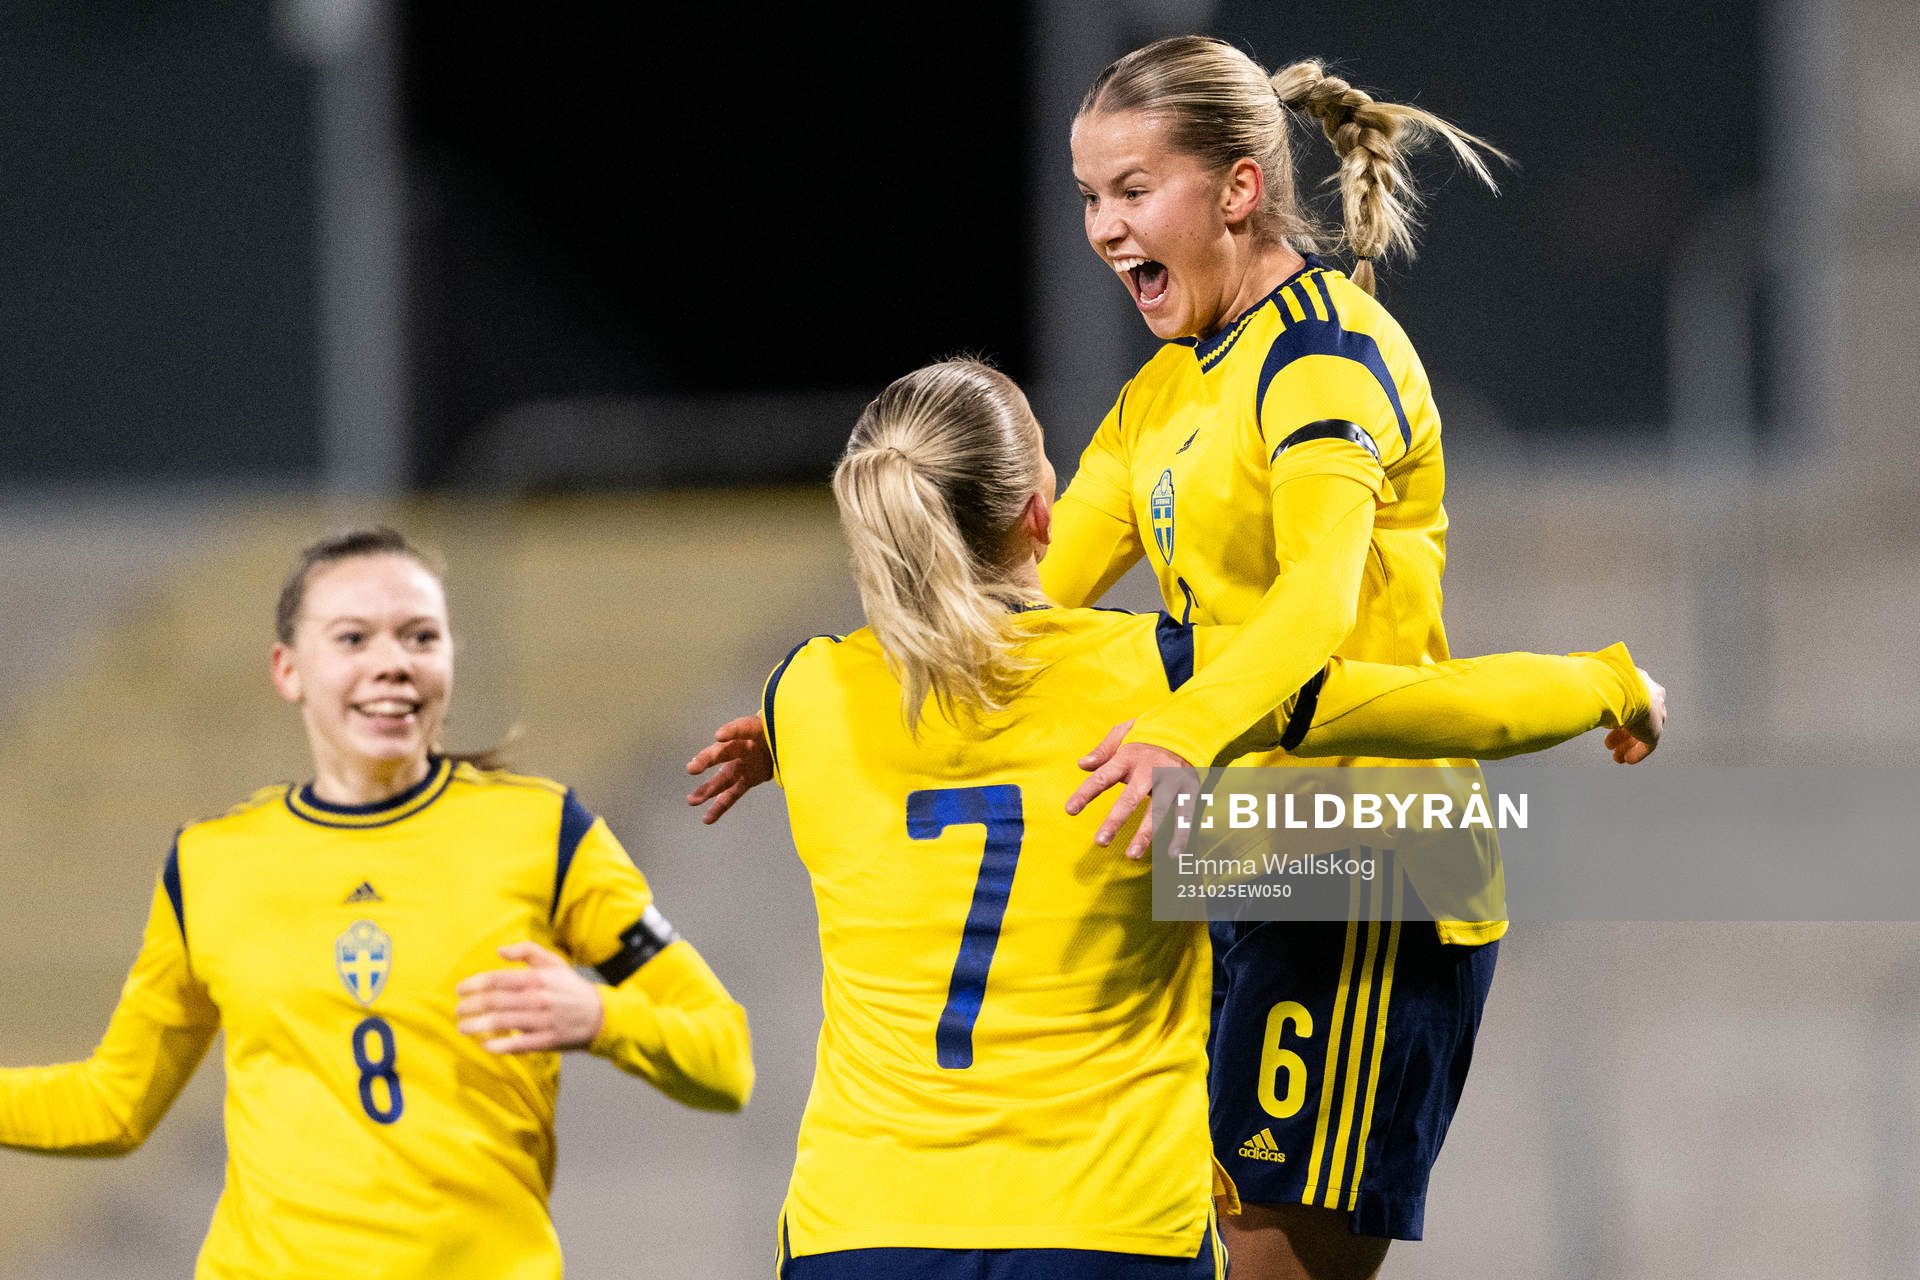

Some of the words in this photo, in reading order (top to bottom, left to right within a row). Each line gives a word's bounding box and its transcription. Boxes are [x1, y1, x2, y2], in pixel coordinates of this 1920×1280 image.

[906, 784, 1024, 1069] 7
[352, 1016, 404, 1125] 8
[1257, 1001, 1314, 1119] 6
[1238, 1147, 1286, 1163] adidas
